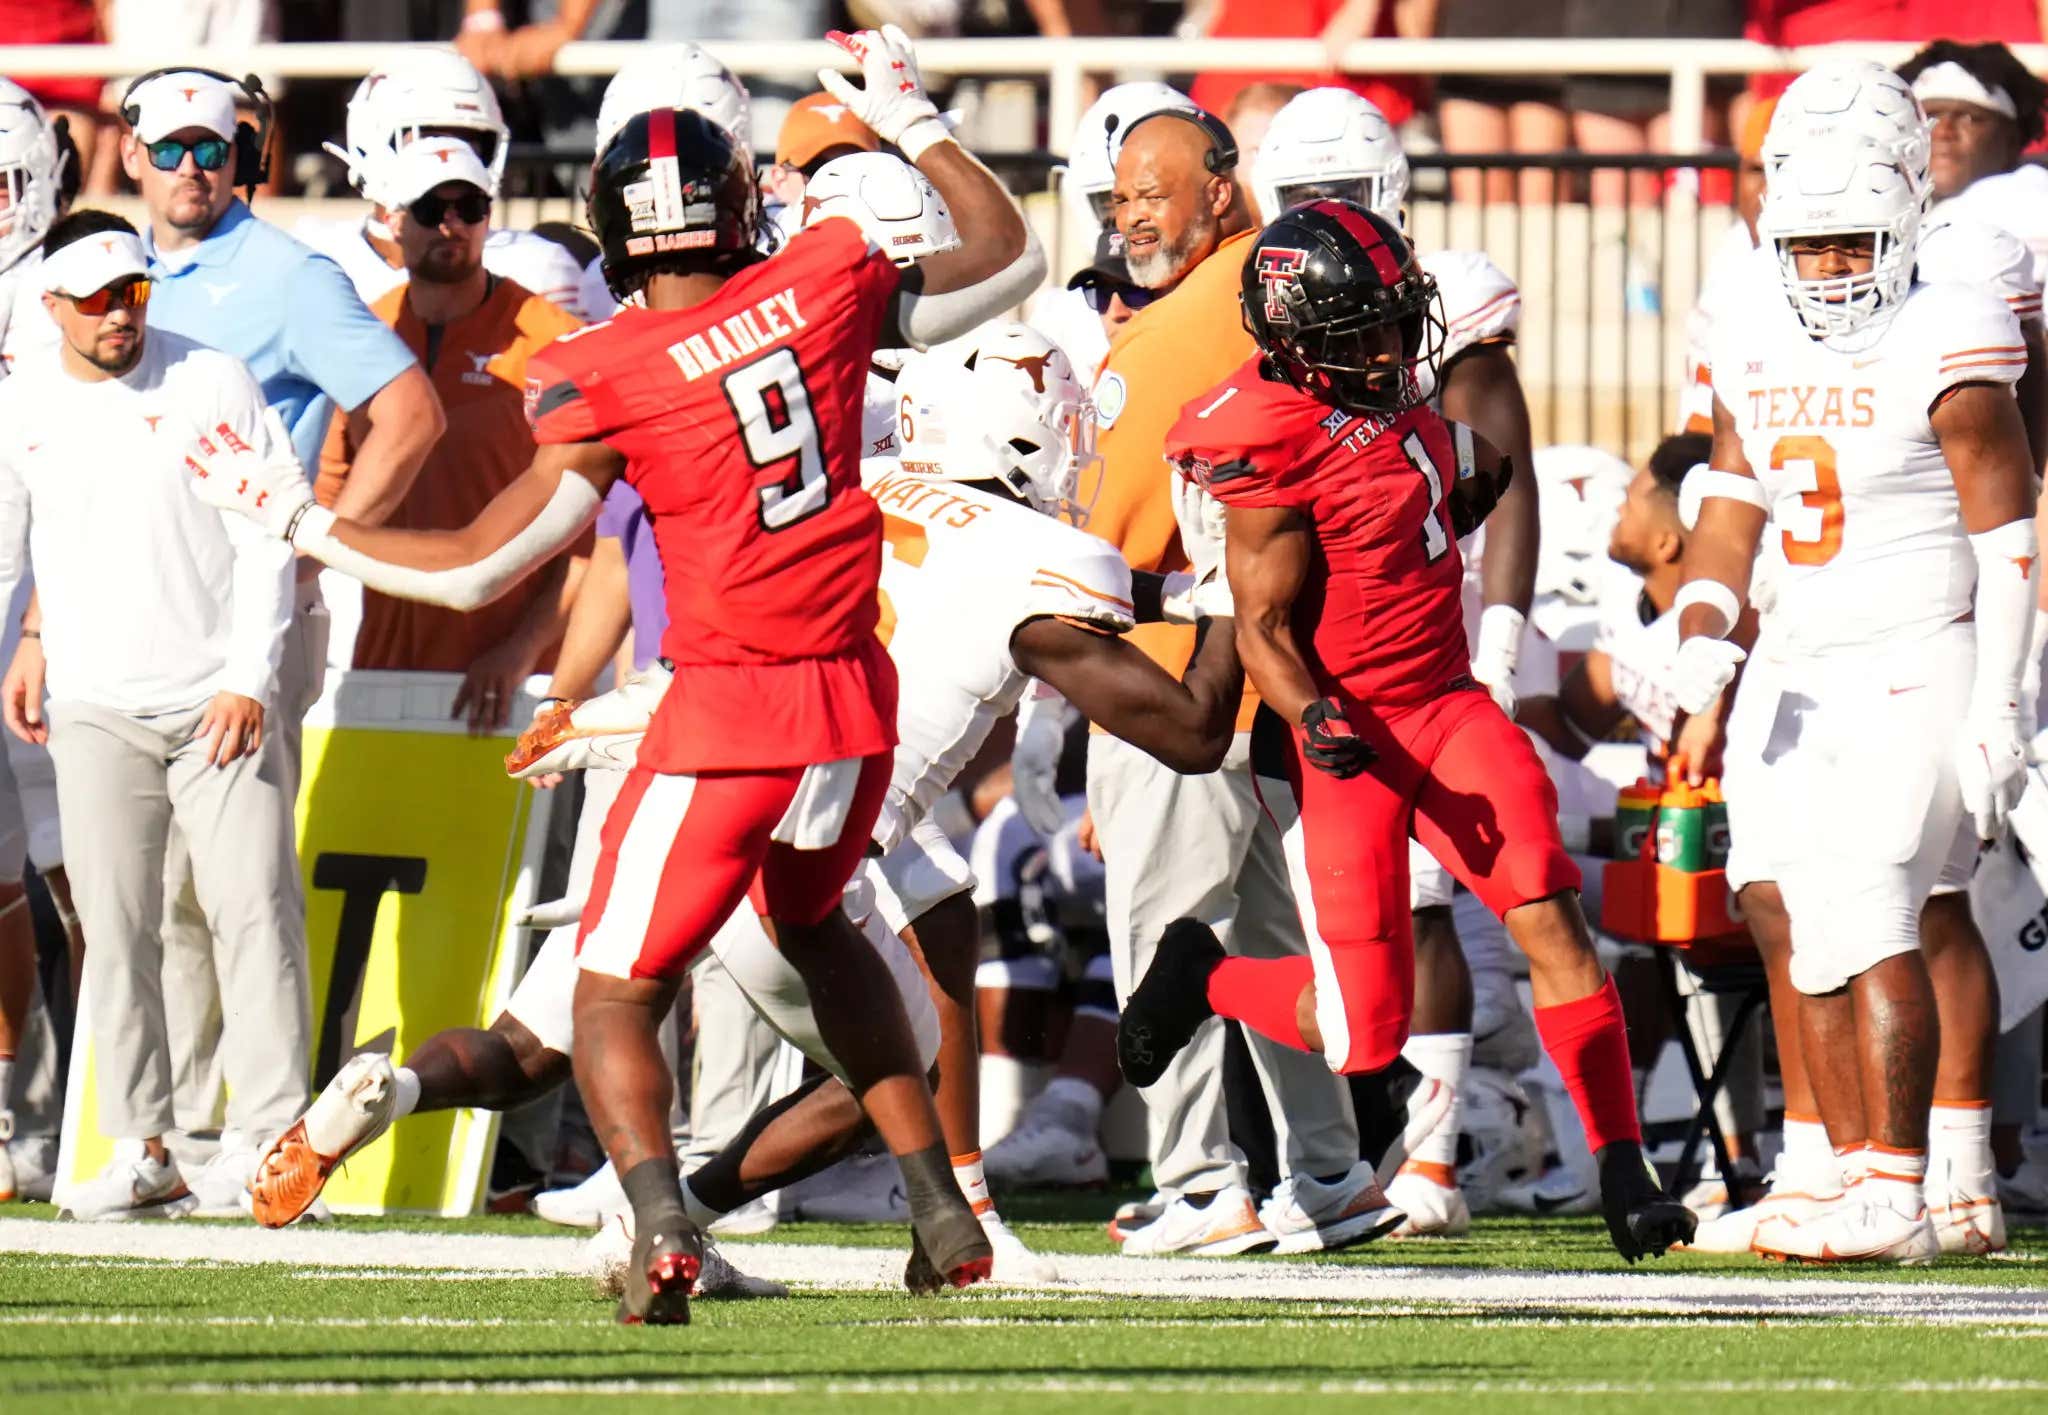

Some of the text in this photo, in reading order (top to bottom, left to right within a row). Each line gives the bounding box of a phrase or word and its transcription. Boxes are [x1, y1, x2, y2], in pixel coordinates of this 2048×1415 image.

[655, 229, 717, 251] RAIDERS
[666, 288, 808, 382] BRADLEY
[901, 394, 914, 443] 6
[1341, 412, 1397, 455] TEXAS
[1747, 386, 1876, 430] TEXAS
[720, 345, 832, 535] 9
[867, 470, 992, 528] WATTS
[1399, 427, 1449, 568] 1
[1769, 435, 1846, 567] 3
